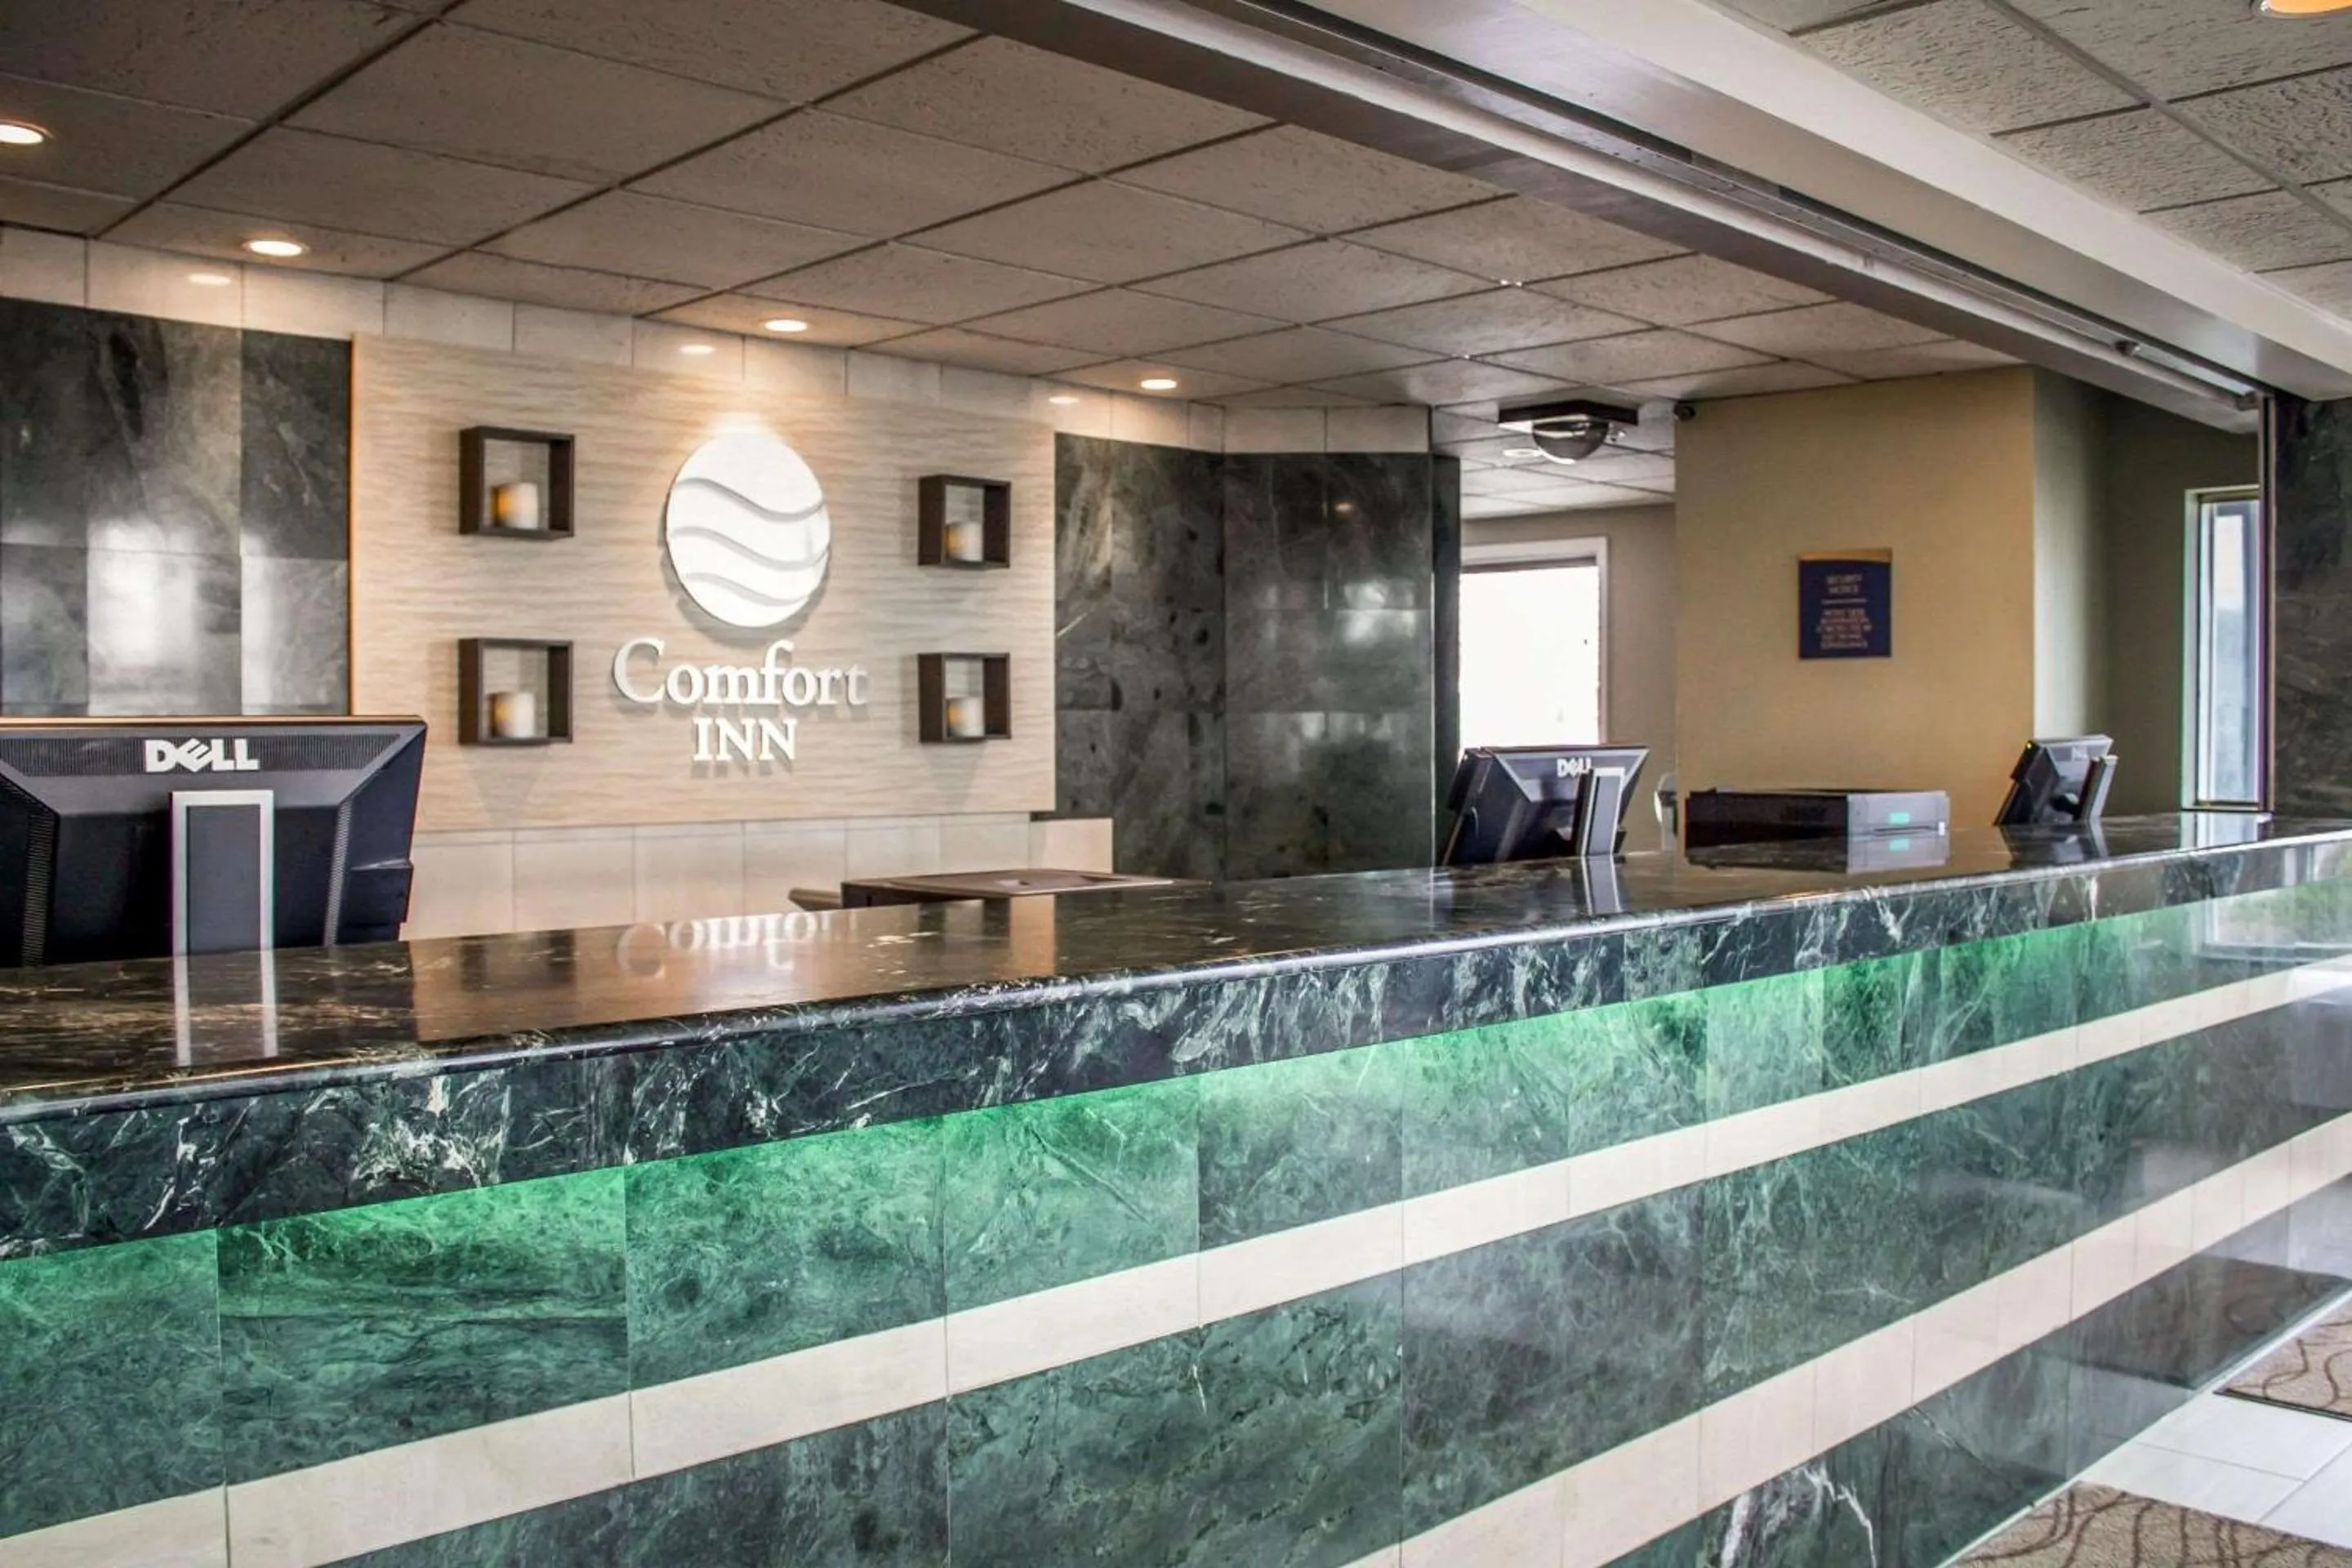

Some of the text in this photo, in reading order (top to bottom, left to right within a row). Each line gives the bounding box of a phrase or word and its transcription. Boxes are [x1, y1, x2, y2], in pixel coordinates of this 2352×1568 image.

[612, 637, 870, 706] Comfort
[145, 737, 260, 773] DELL
[693, 716, 799, 761] INN
